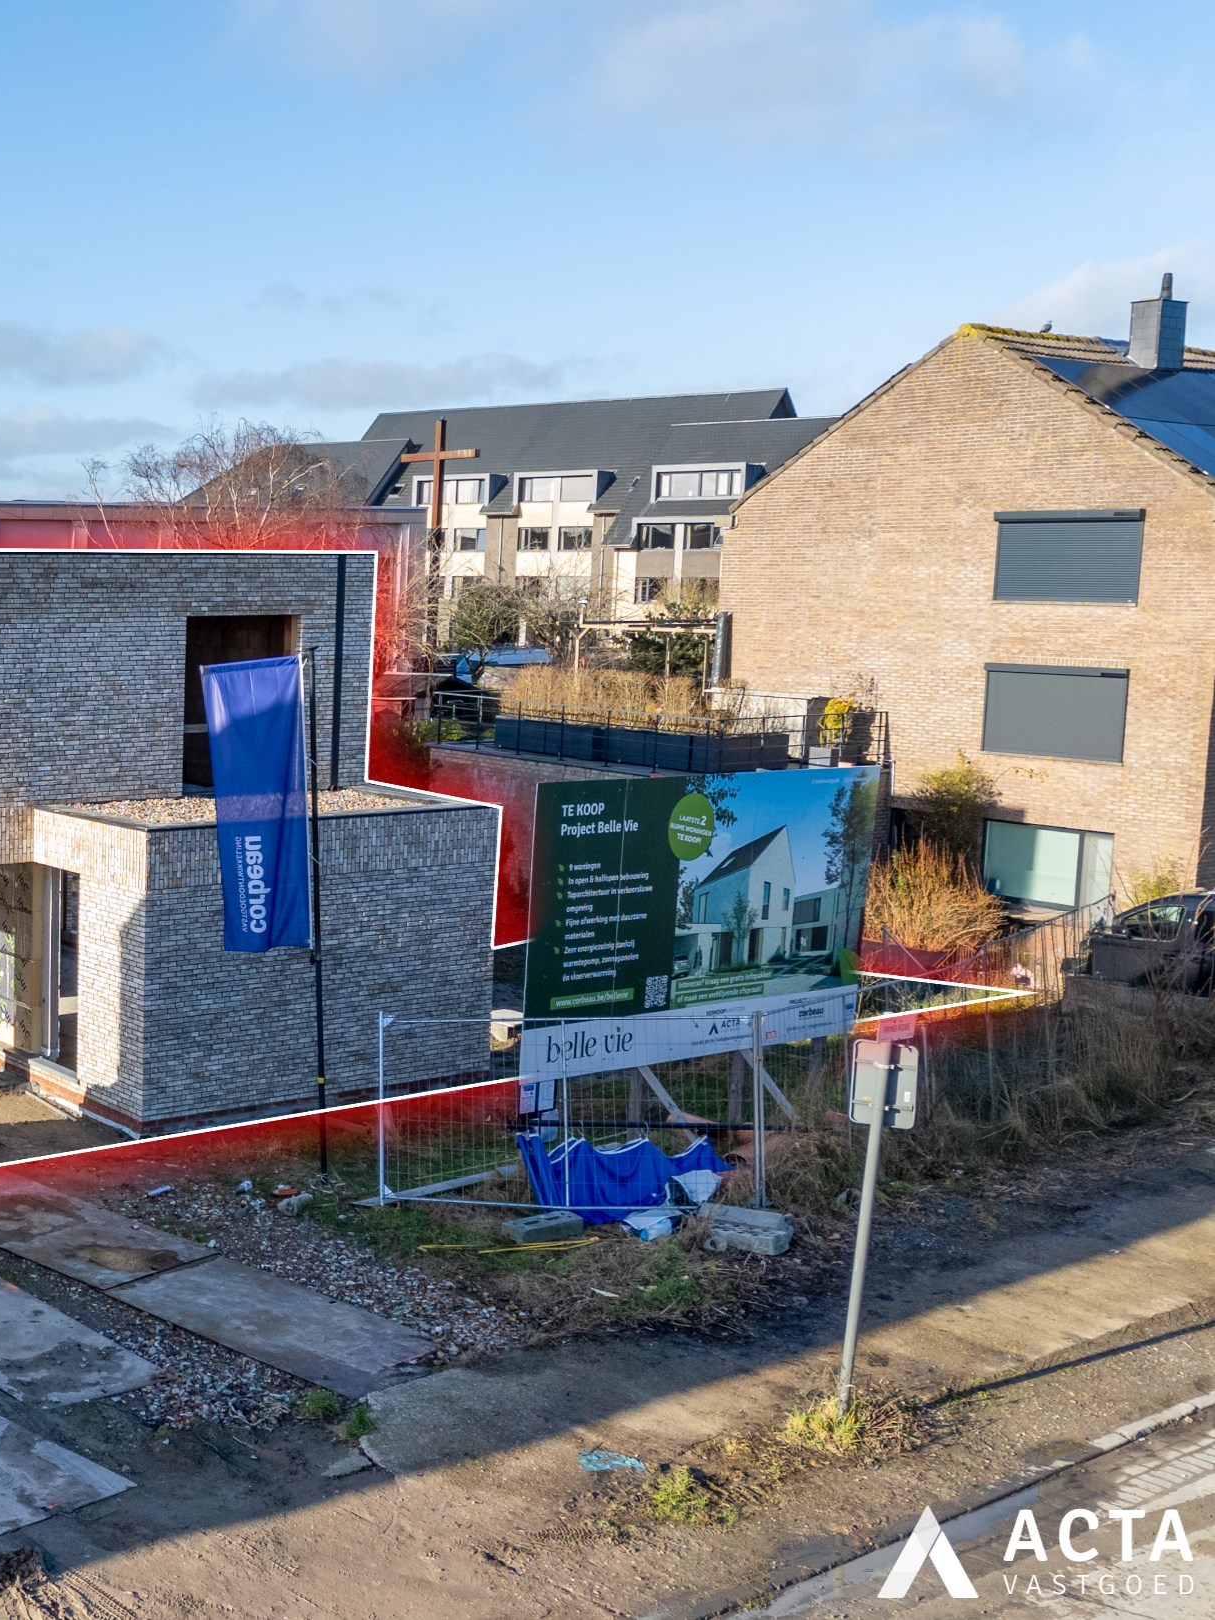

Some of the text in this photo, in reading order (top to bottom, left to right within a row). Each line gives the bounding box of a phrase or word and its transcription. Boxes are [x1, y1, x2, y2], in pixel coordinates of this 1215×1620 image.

[561, 802, 605, 817] TE KOOP
[700, 815, 707, 826] 2
[560, 819, 639, 838] Project Belle Vie
[677, 832, 685, 841] TE
[568, 862, 601, 872] 9 woningen
[568, 871, 650, 886] In open & halfopen bebouwing
[567, 888, 610, 900] Toparchitectuur
[610, 887, 617, 895] in
[566, 903, 593, 914] omgeving
[580, 914, 609, 925] afwerking
[608, 914, 620, 922] met
[564, 930, 595, 941] materialen
[564, 946, 577, 954] Zeer
[577, 941, 615, 953] energiezuinig
[601, 952, 639, 964] zonnepanelen
[570, 968, 617, 981] vloerverwarming
[704, 977, 720, 987] Vraag
[555, 990, 629, 1007] www.corbeau.be/bellevie
[683, 993, 698, 1002] maak
[721, 1017, 741, 1029] ACTA
[545, 1025, 633, 1064] belle vie
